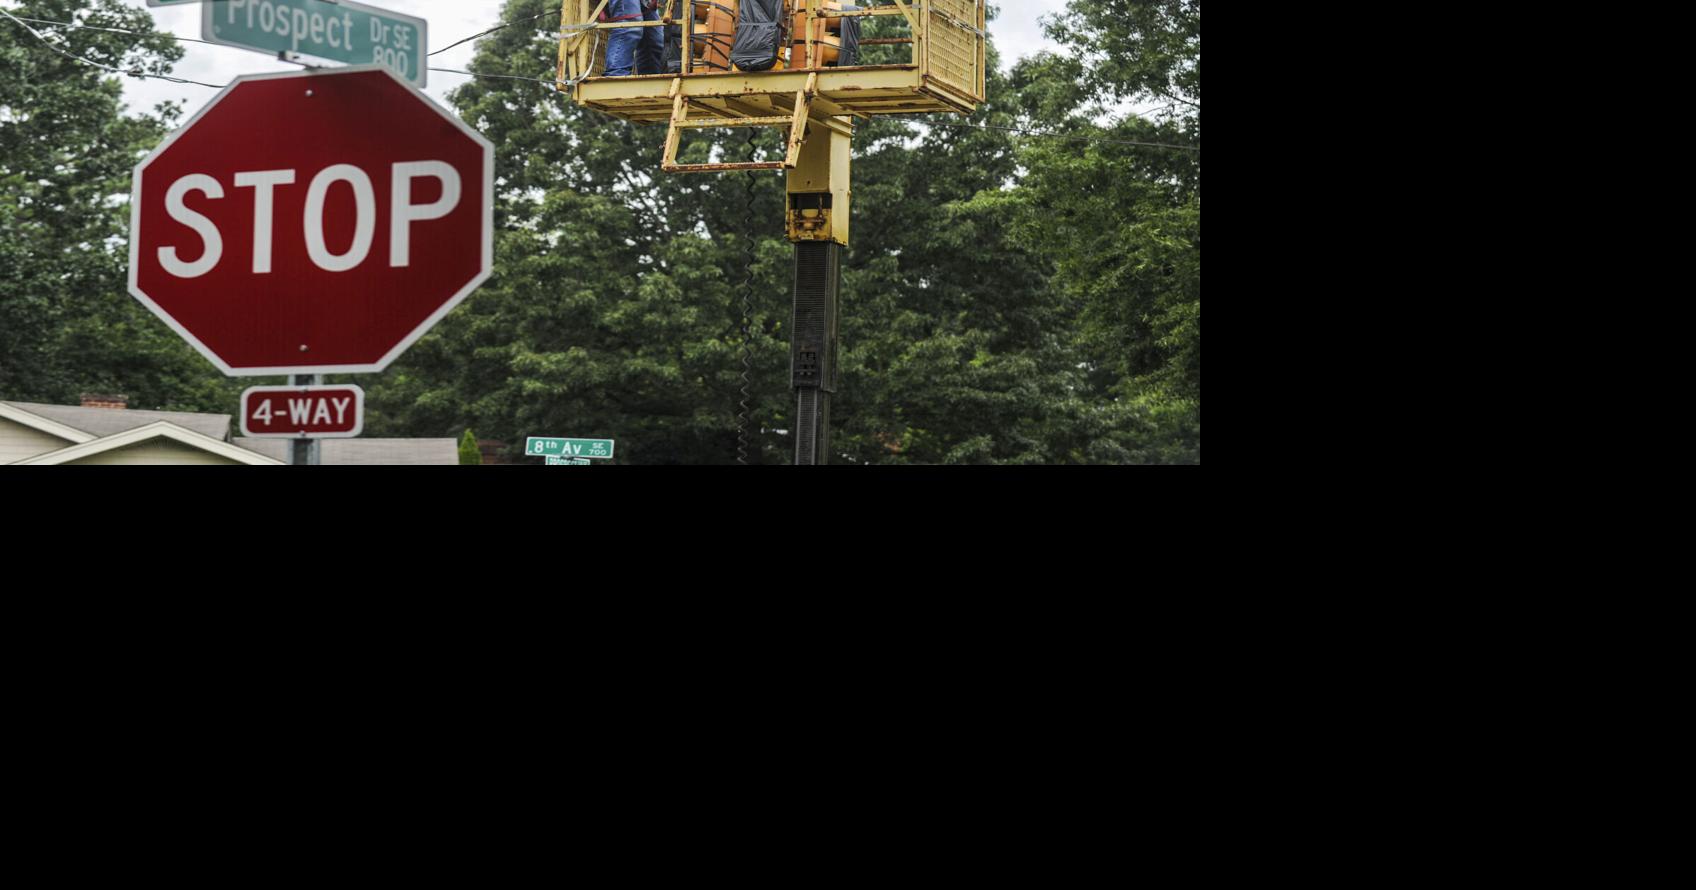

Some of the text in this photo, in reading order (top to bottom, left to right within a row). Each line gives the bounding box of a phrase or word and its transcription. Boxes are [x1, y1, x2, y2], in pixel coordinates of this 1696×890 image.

[226, 0, 411, 51] Prospect Dr SE
[372, 44, 409, 78] 800
[157, 160, 462, 278] STOP
[252, 397, 350, 425] 4-WAY
[534, 440, 582, 455] 8th Av
